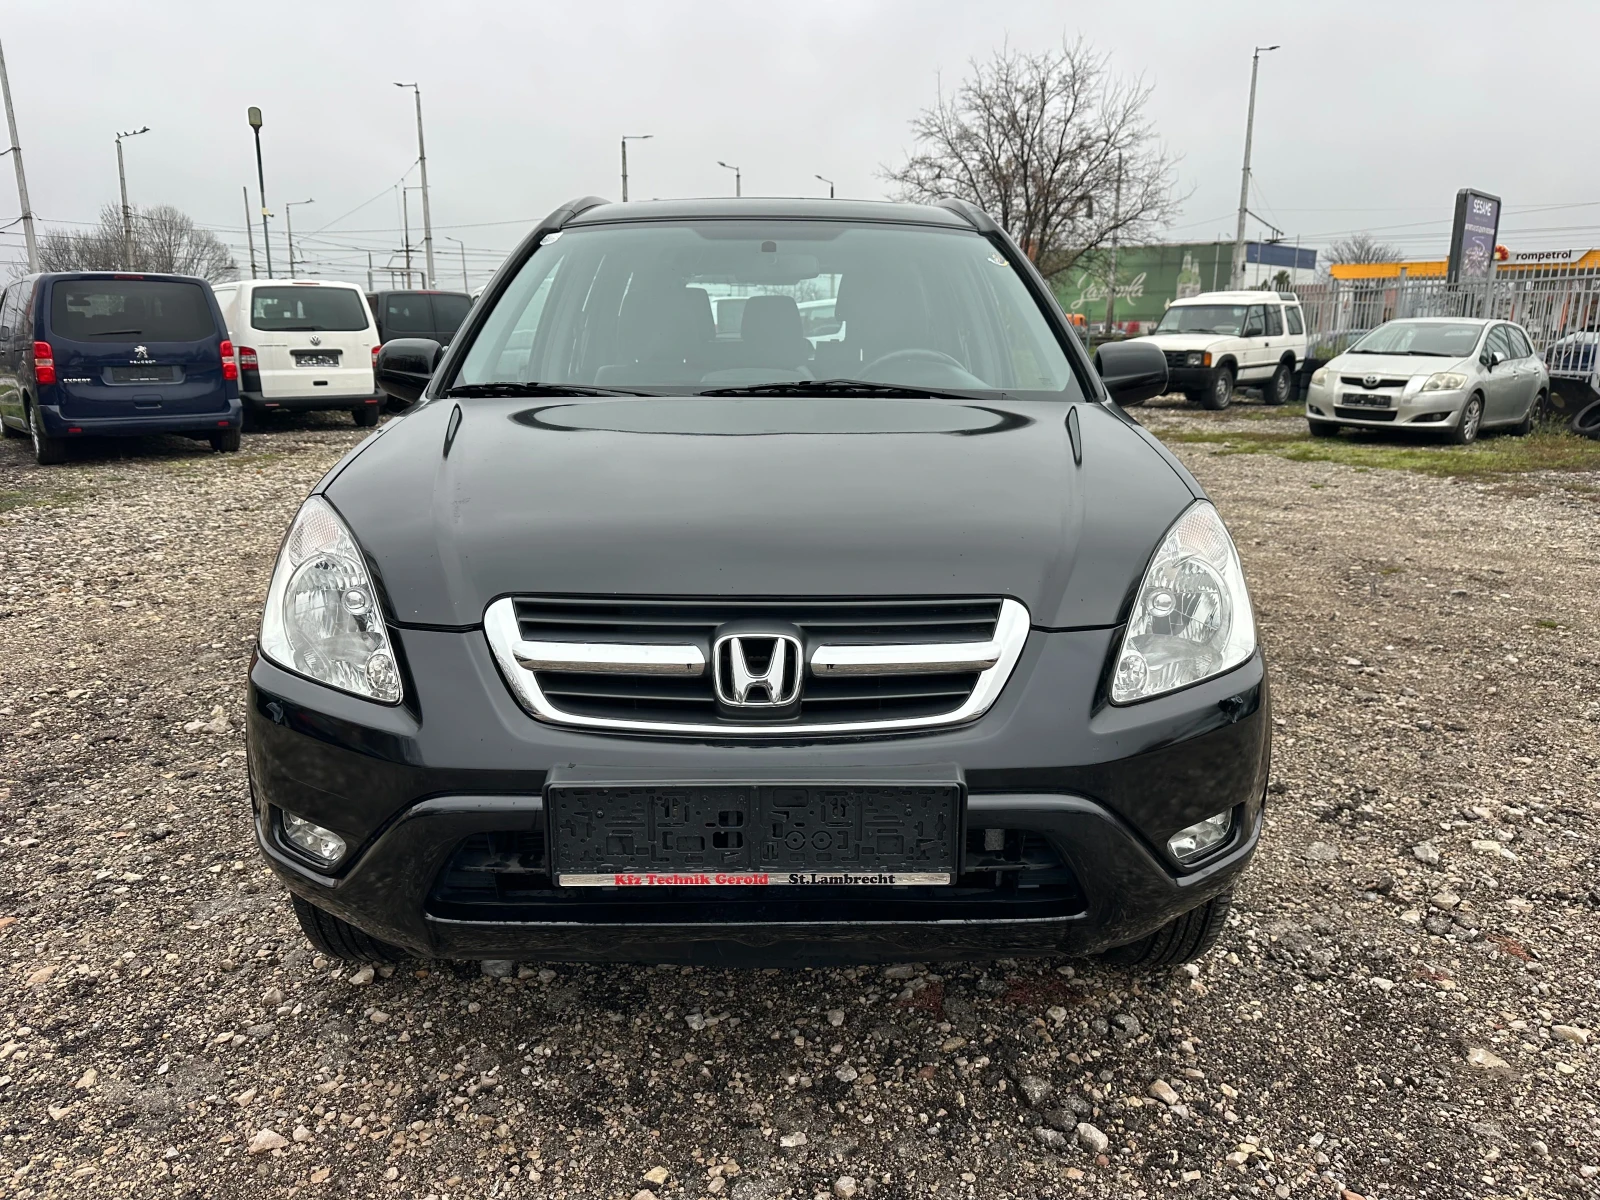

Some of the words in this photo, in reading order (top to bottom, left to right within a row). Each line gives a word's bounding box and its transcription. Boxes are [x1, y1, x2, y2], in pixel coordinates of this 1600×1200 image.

[1516, 249, 1572, 262] rompetrol
[614, 874, 642, 885] Kfz
[645, 874, 711, 885] Technik
[715, 873, 769, 885] Gerold
[788, 873, 896, 885] St.Lambrecht
